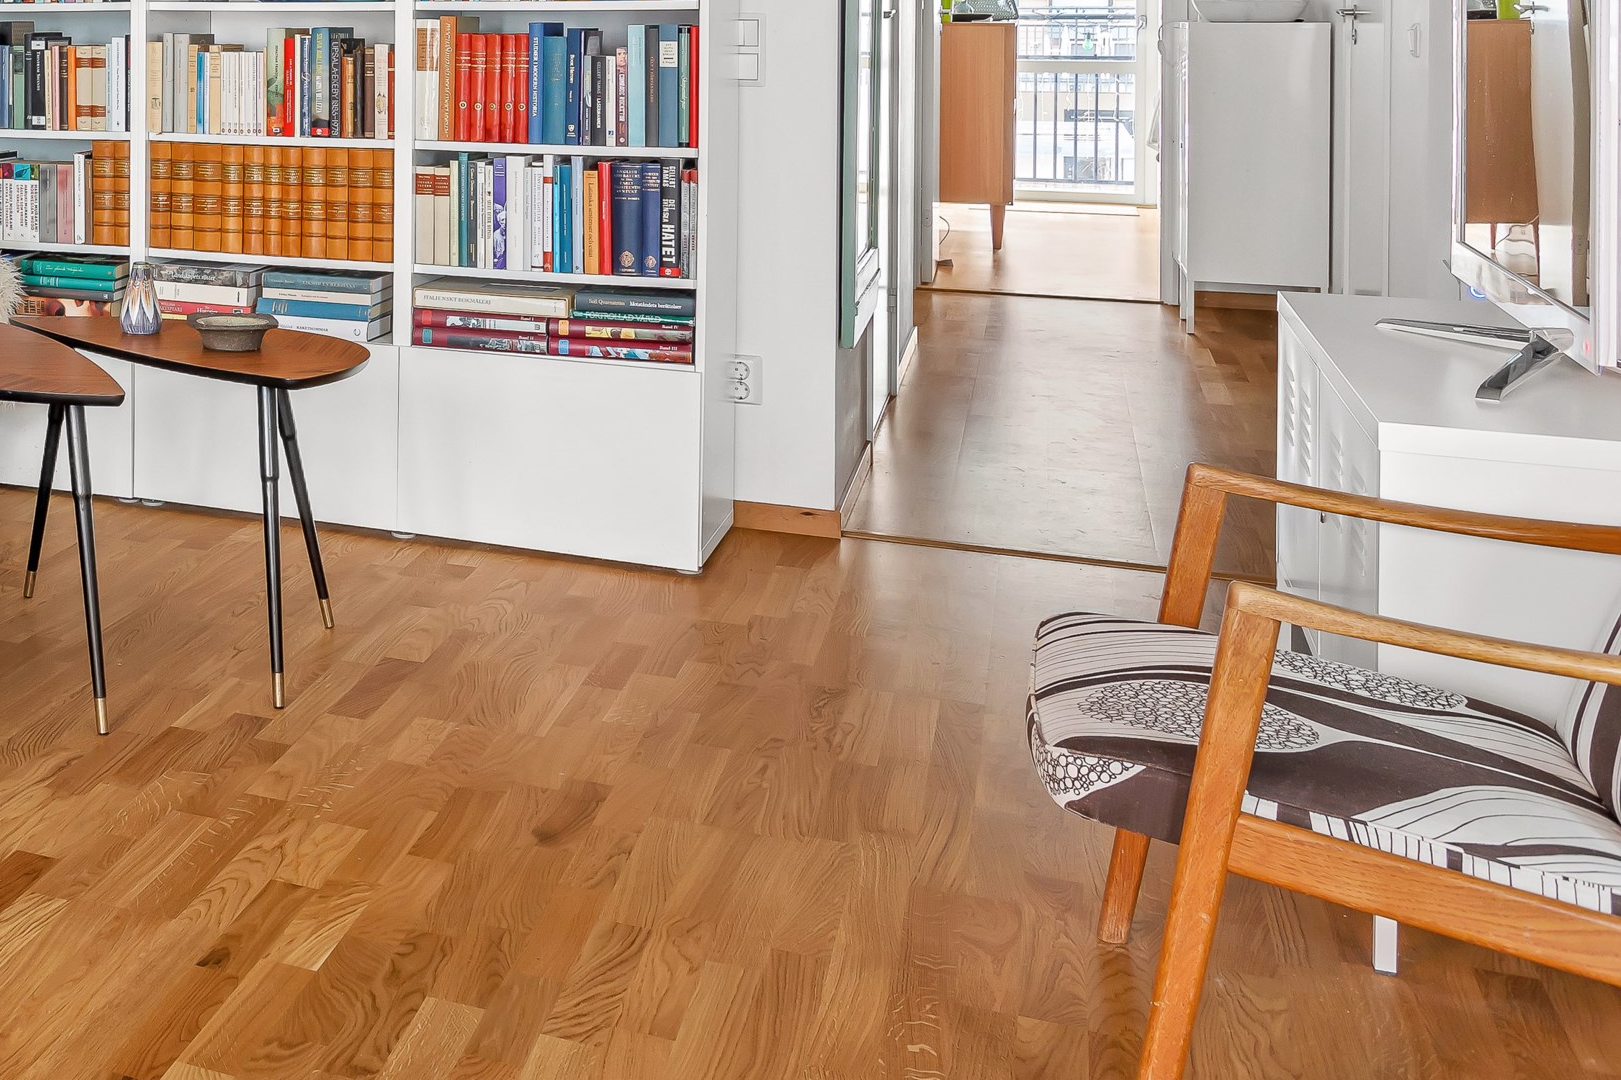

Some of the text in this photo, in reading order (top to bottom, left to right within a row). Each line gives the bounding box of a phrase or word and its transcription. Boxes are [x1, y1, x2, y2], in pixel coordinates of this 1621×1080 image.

[330, 40, 340, 100] UPSALA-EKEBY
[530, 36, 540, 118] STUDIER MODERN HISTORIA
[668, 198, 677, 211] DET
[660, 223, 676, 265] HATET
[422, 293, 492, 308] ITALIENSKT BOKMÅLERI
